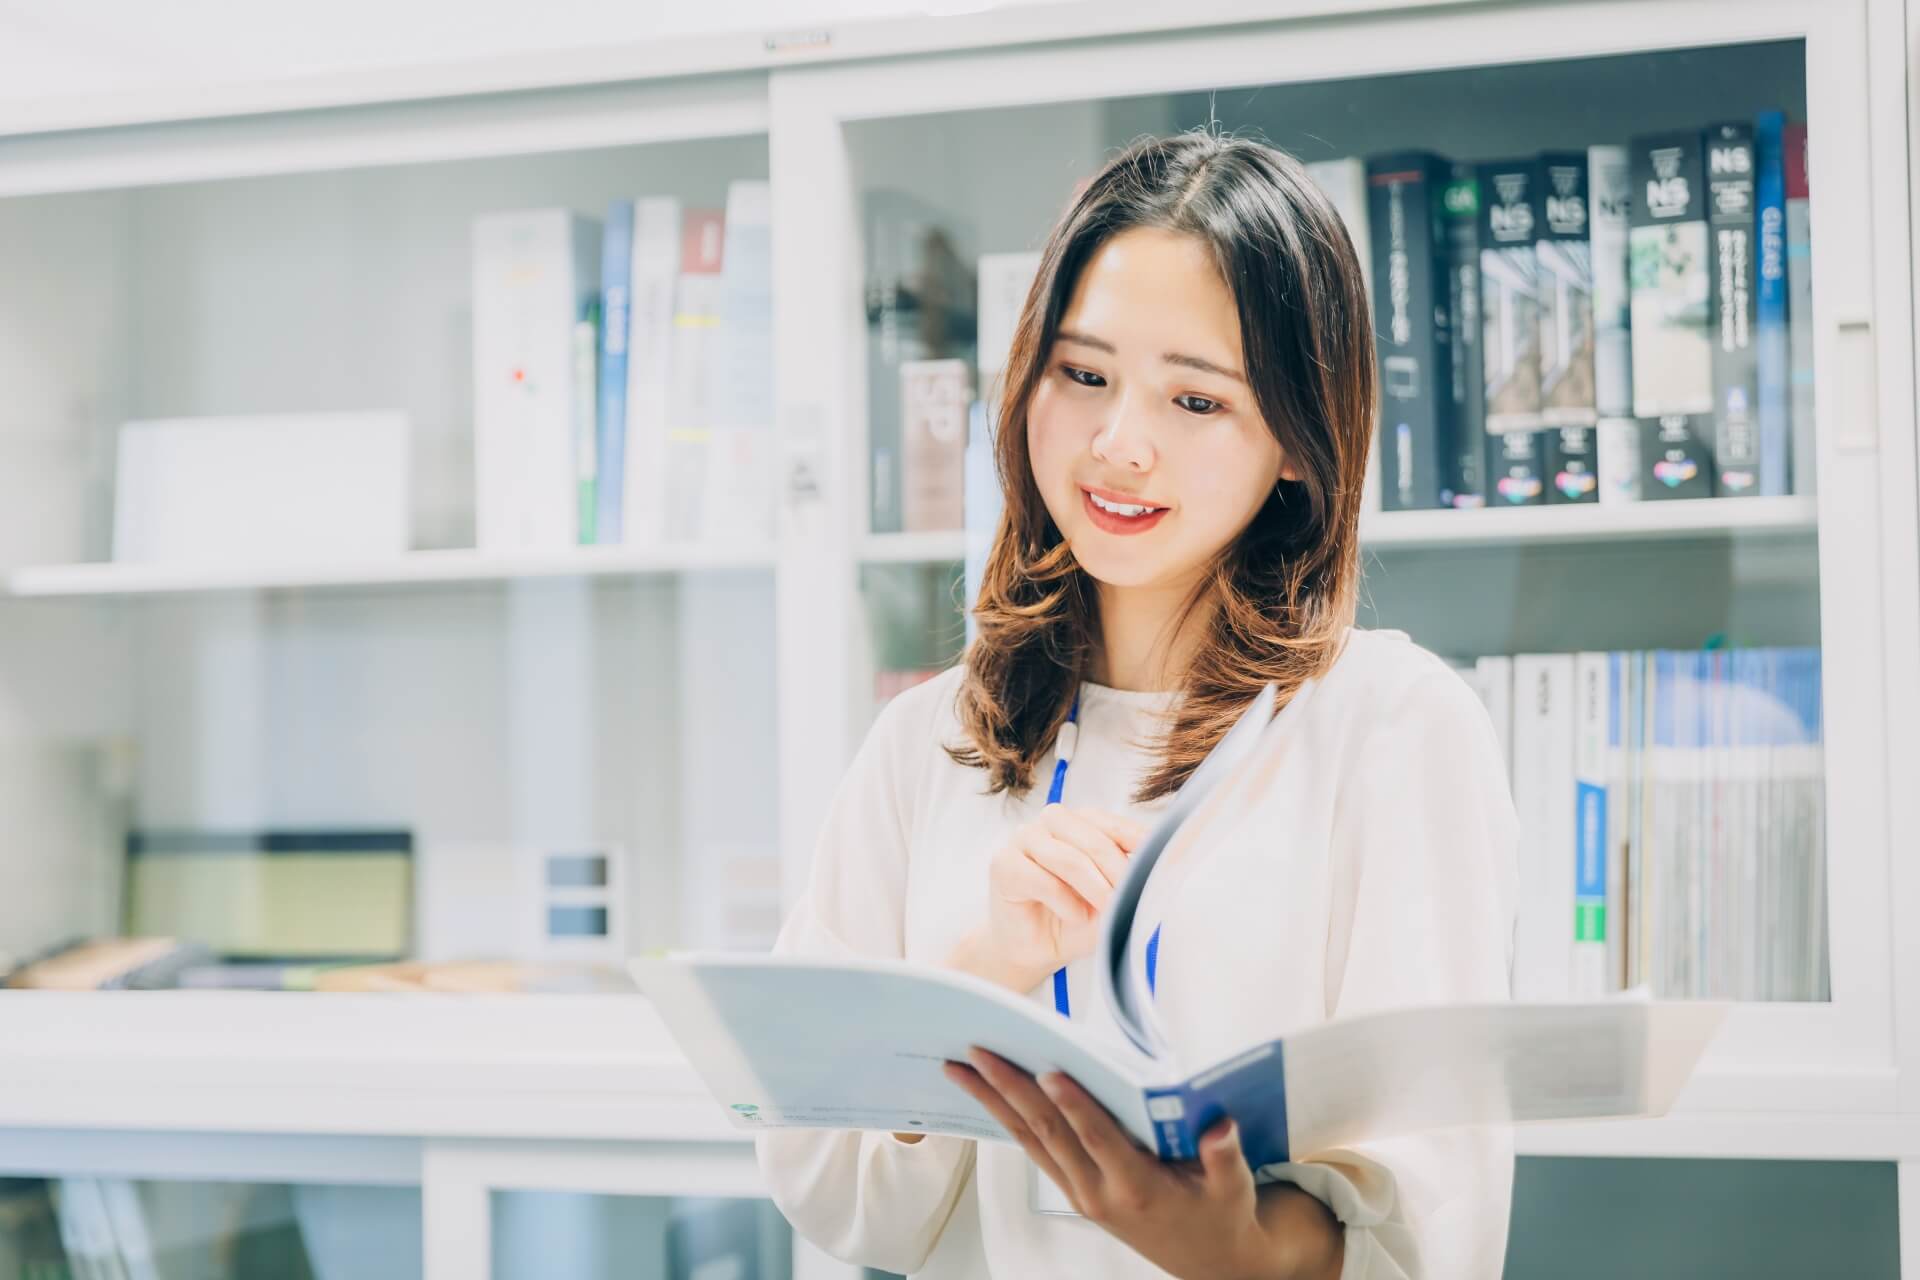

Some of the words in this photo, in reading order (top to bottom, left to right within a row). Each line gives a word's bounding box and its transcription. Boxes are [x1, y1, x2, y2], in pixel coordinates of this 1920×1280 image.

[1711, 147, 1751, 173] NS
[1647, 177, 1690, 208] NS
[1490, 202, 1534, 231] NS
[1546, 195, 1586, 223] NS
